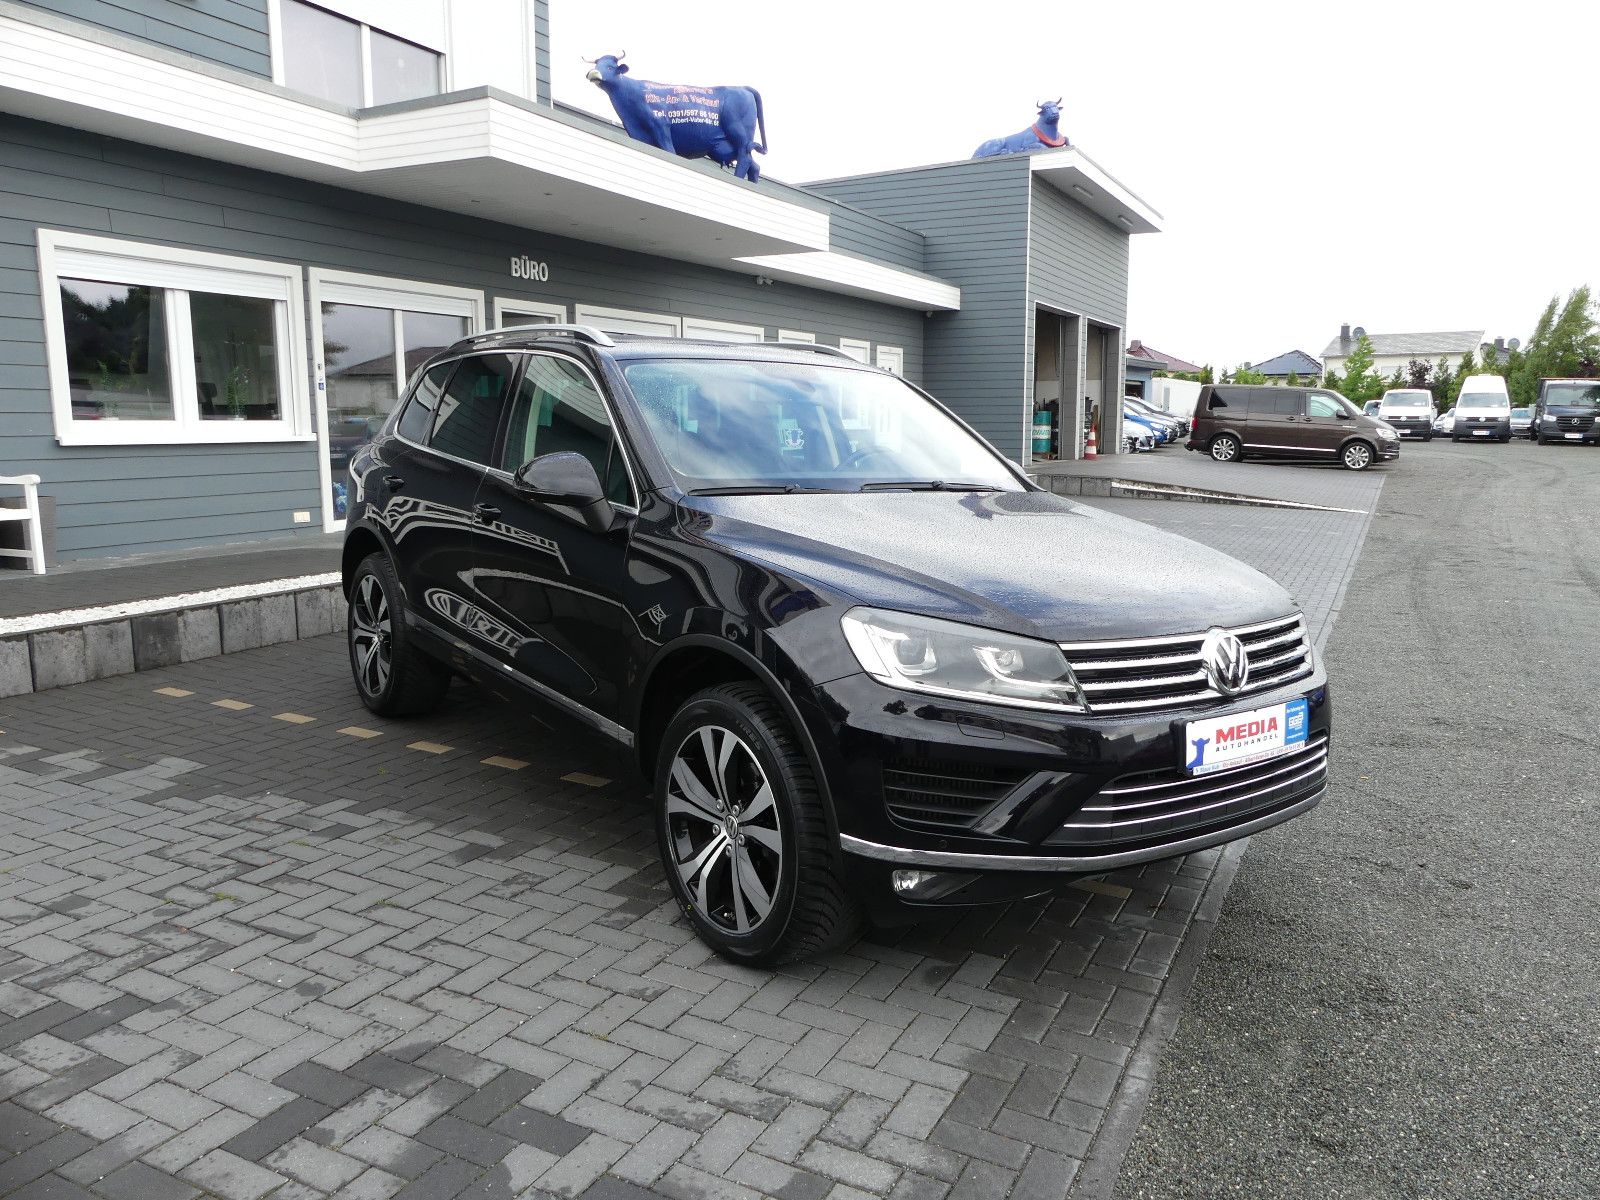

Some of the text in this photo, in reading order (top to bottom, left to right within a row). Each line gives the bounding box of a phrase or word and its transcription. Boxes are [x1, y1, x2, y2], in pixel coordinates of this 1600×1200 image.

[653, 109, 667, 118] Tel.
[510, 255, 549, 282] BÜRO
[1215, 716, 1278, 745] MEDIA
[1215, 733, 1279, 753] AUTOHANDEL
